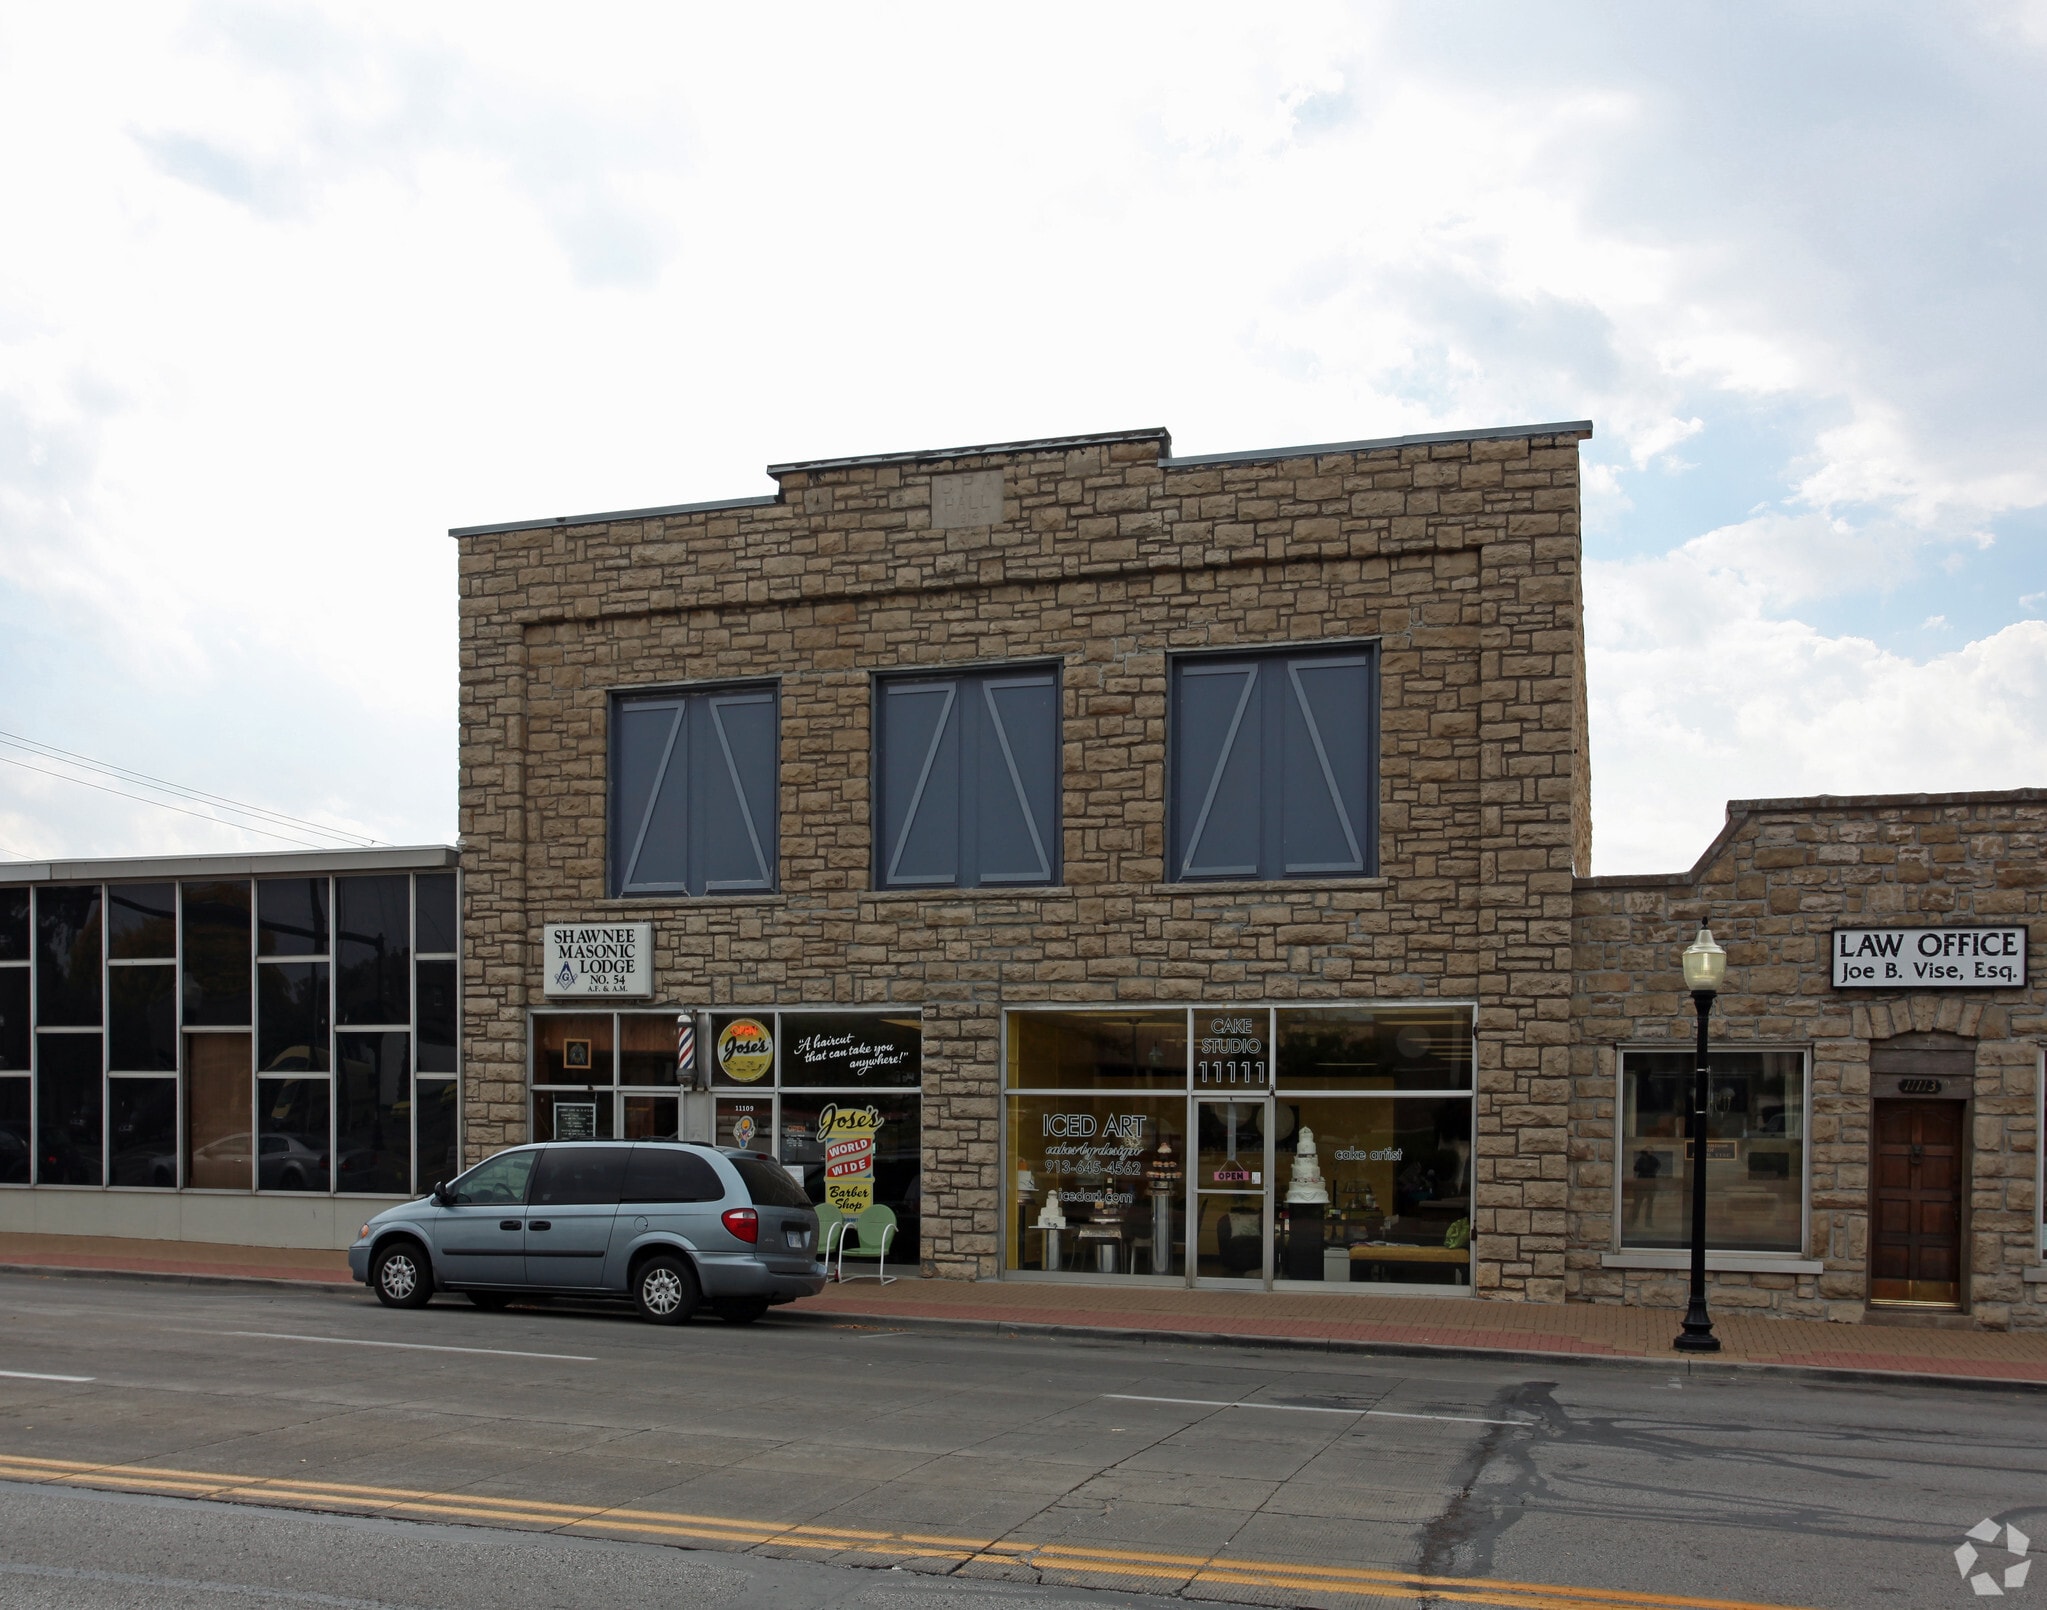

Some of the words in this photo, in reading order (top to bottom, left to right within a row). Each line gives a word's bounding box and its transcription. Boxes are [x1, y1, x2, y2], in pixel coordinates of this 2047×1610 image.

[554, 929, 635, 943] SHAWNEE
[559, 944, 635, 958] MASONIC
[1840, 934, 1904, 957] LAW
[1917, 933, 2018, 957] OFFICE
[580, 960, 635, 973] LODGE
[1841, 962, 1875, 983] Joe
[1885, 962, 1903, 979] B.
[1913, 962, 1964, 980] Vise,
[1974, 962, 2018, 982] Esq.
[590, 974, 609, 985] NO.
[613, 974, 626, 985] 54
[730, 1025, 758, 1037] OPEN
[1211, 1018, 1252, 1034] CAKE
[813, 1033, 855, 1049] haircut
[1201, 1038, 1262, 1054] STUDIO
[723, 1036, 769, 1063] Jose's
[804, 1050, 827, 1063] that
[829, 1050, 848, 1059] can
[848, 1042, 873, 1056] take
[874, 1043, 895, 1057] you
[849, 1051, 909, 1076] anywhere!"
[1198, 1061, 1265, 1083] 11111
[818, 1103, 881, 1141] Jose's
[1043, 1113, 1097, 1137] ICED
[1102, 1113, 1147, 1138] ART
[829, 1139, 868, 1158] WORLD
[1046, 1142, 1077, 1155] cakes
[1079, 1142, 1099, 1160] by
[1098, 1143, 1145, 1160] design
[1335, 1146, 1366, 1160] cake
[1370, 1147, 1403, 1161] artist
[832, 1159, 866, 1176] WIDE
[1045, 1160, 1141, 1175] 913-645-4562
[1218, 1172, 1244, 1180] OPEN
[829, 1186, 869, 1198] Barber
[1058, 1187, 1133, 1204] icedart.com
[835, 1199, 864, 1212] Shop
